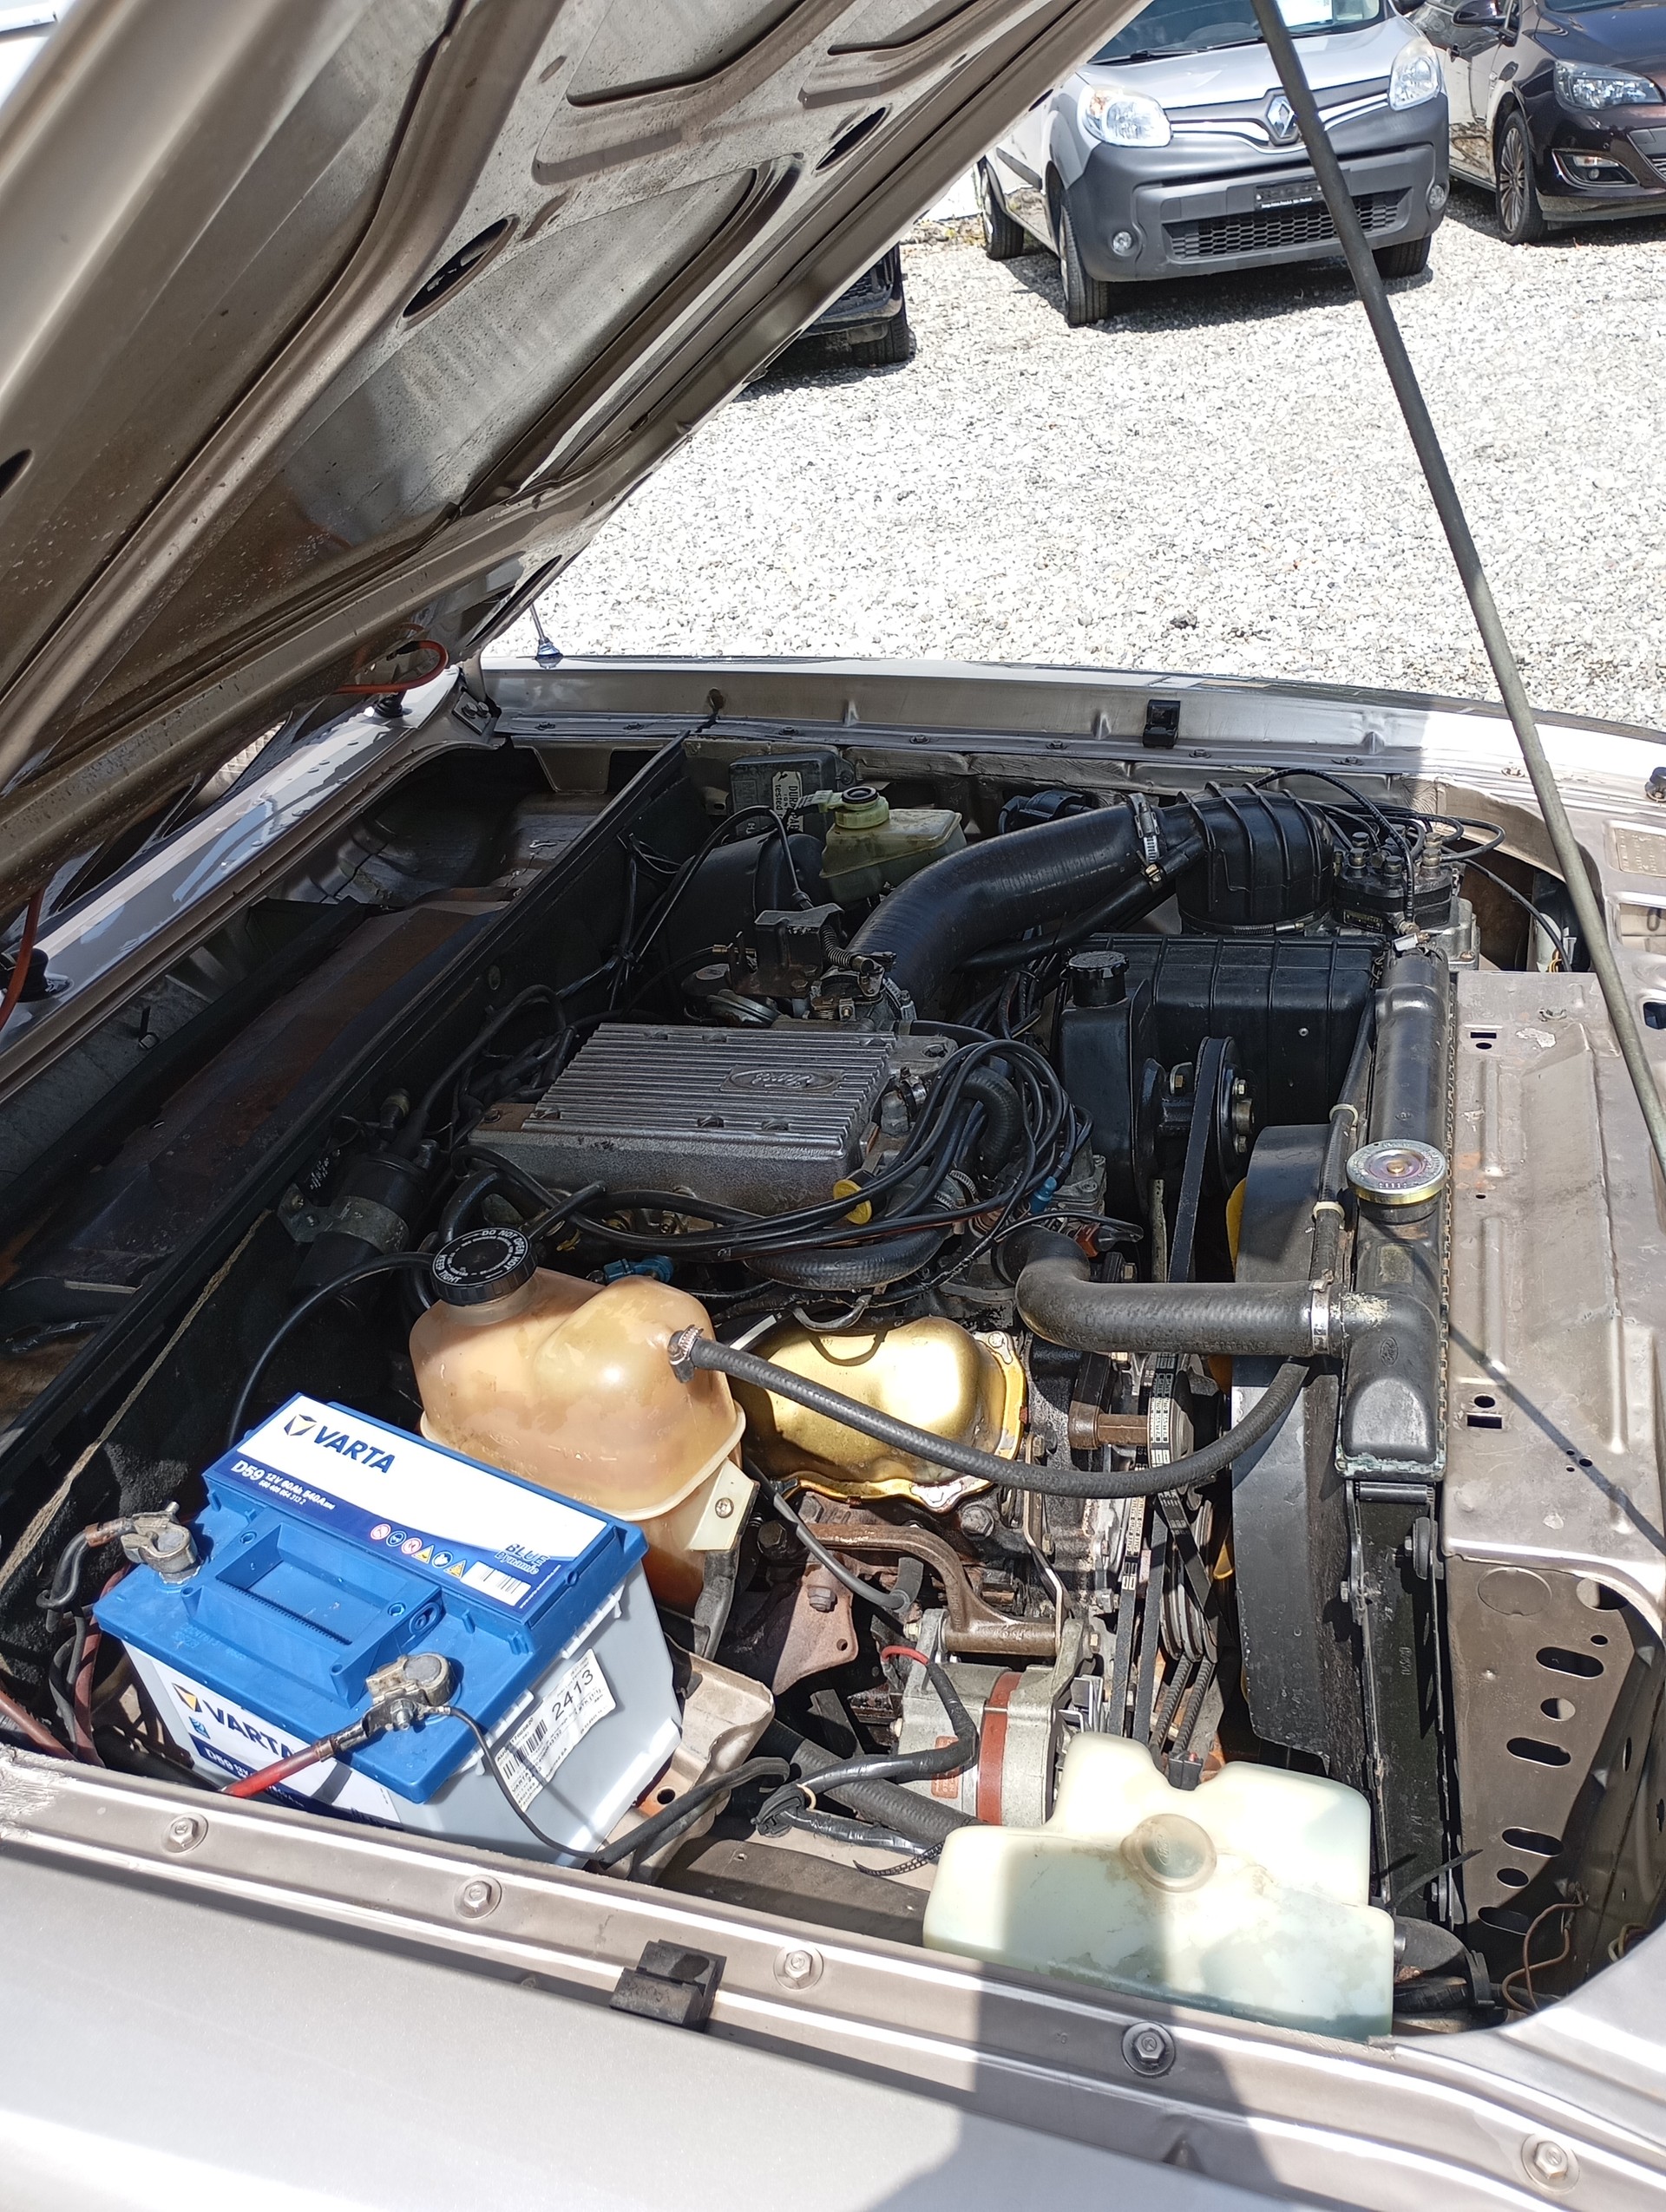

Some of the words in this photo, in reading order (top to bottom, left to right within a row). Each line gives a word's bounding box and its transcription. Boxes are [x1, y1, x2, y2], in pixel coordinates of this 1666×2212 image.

[775, 784, 784, 811] tested
[498, 1229, 518, 1240] NOT
[513, 1238, 526, 1255] OPEN
[436, 1253, 449, 1271] KEEP
[503, 1255, 521, 1272] HOT
[438, 1269, 462, 1284] TIGHT
[313, 1425, 397, 1474] VARTA
[231, 1460, 266, 1481] D59
[265, 1472, 284, 1484] 12V
[280, 1480, 303, 1495] 60Ah
[494, 1550, 540, 1575] Dynamic
[505, 1543, 550, 1567] BLUE
[552, 1669, 594, 1722] 2413
[201, 1698, 295, 1760] VARTA
